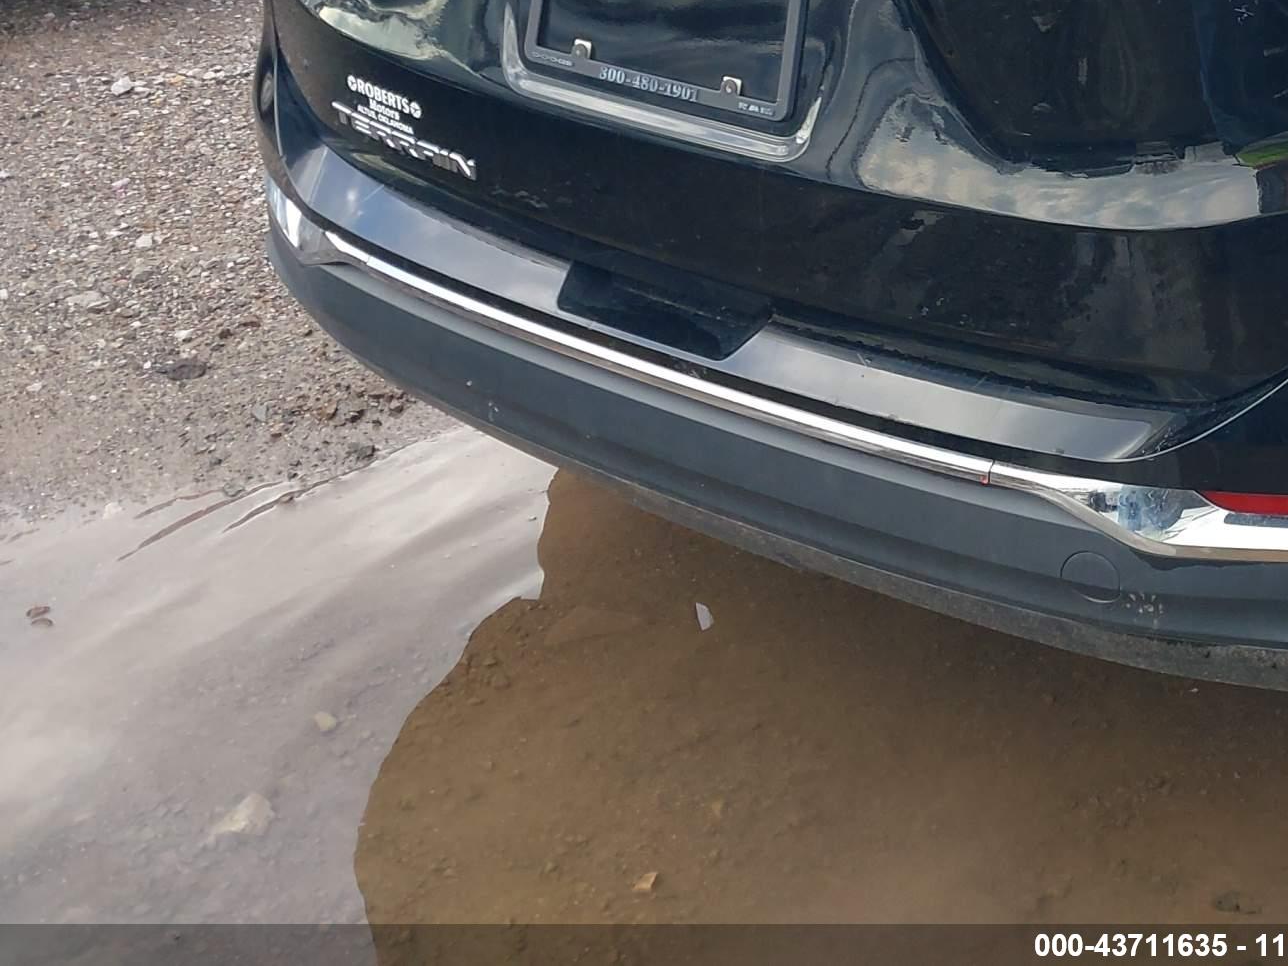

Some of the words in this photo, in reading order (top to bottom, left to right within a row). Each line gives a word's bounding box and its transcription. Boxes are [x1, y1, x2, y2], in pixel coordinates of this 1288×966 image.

[356, 78, 410, 114] ROBERTS
[598, 65, 699, 102] 800-480-1901
[369, 98, 400, 121] Motors
[331, 101, 477, 181] TERRAIN
